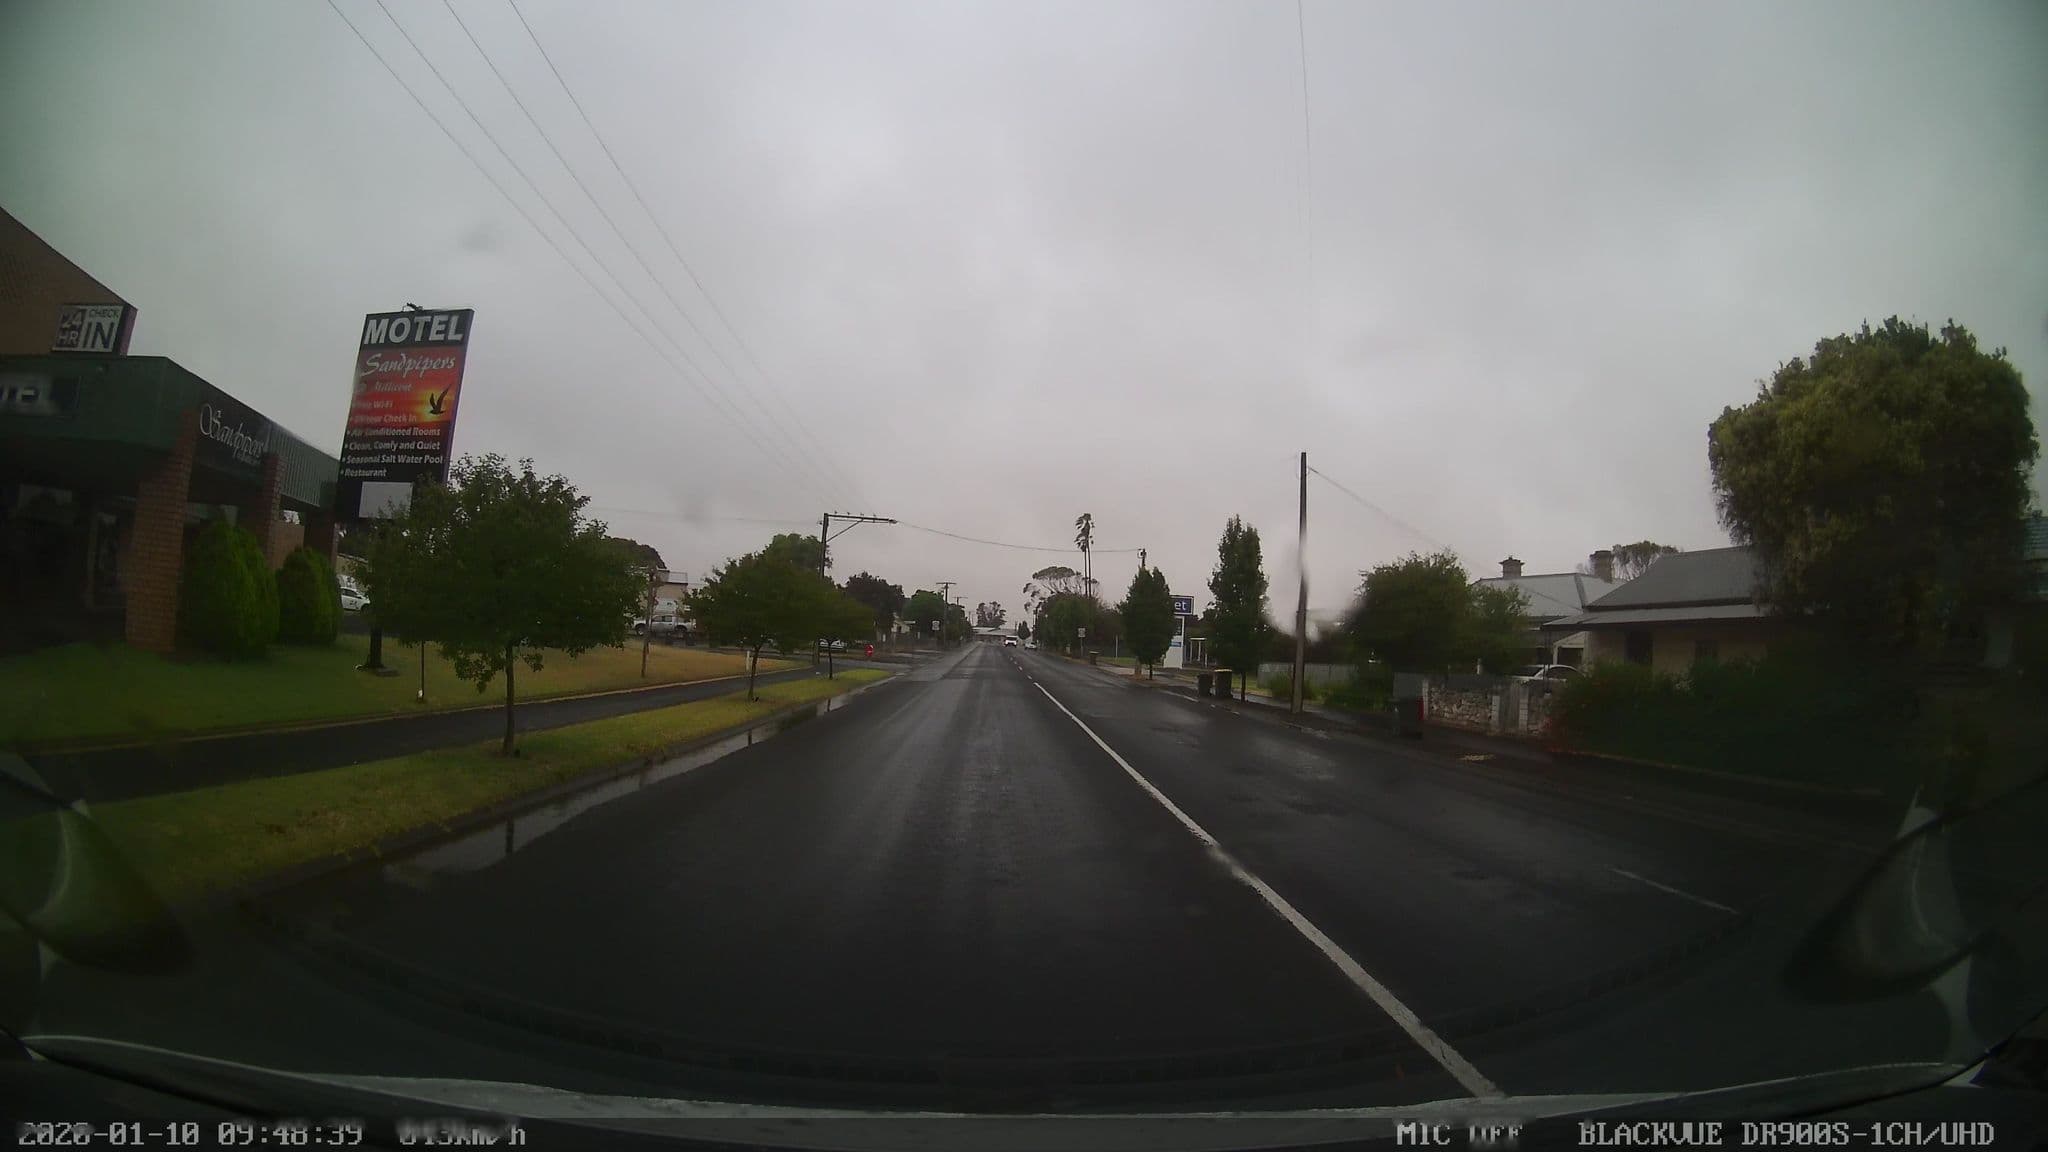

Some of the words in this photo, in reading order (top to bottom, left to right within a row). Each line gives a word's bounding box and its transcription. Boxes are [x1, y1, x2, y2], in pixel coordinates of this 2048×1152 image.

[82, 321, 115, 349] IN
[363, 315, 465, 345] MOTEL
[359, 353, 456, 378] Sandpipers
[412, 427, 441, 437] Rooms
[398, 441, 415, 450] and
[416, 440, 440, 450] Quiet
[346, 455, 380, 464] Seasonal
[381, 454, 396, 464] Salt
[397, 455, 423, 464] Water
[424, 454, 443, 464] Pool
[344, 468, 388, 478] Restaurant
